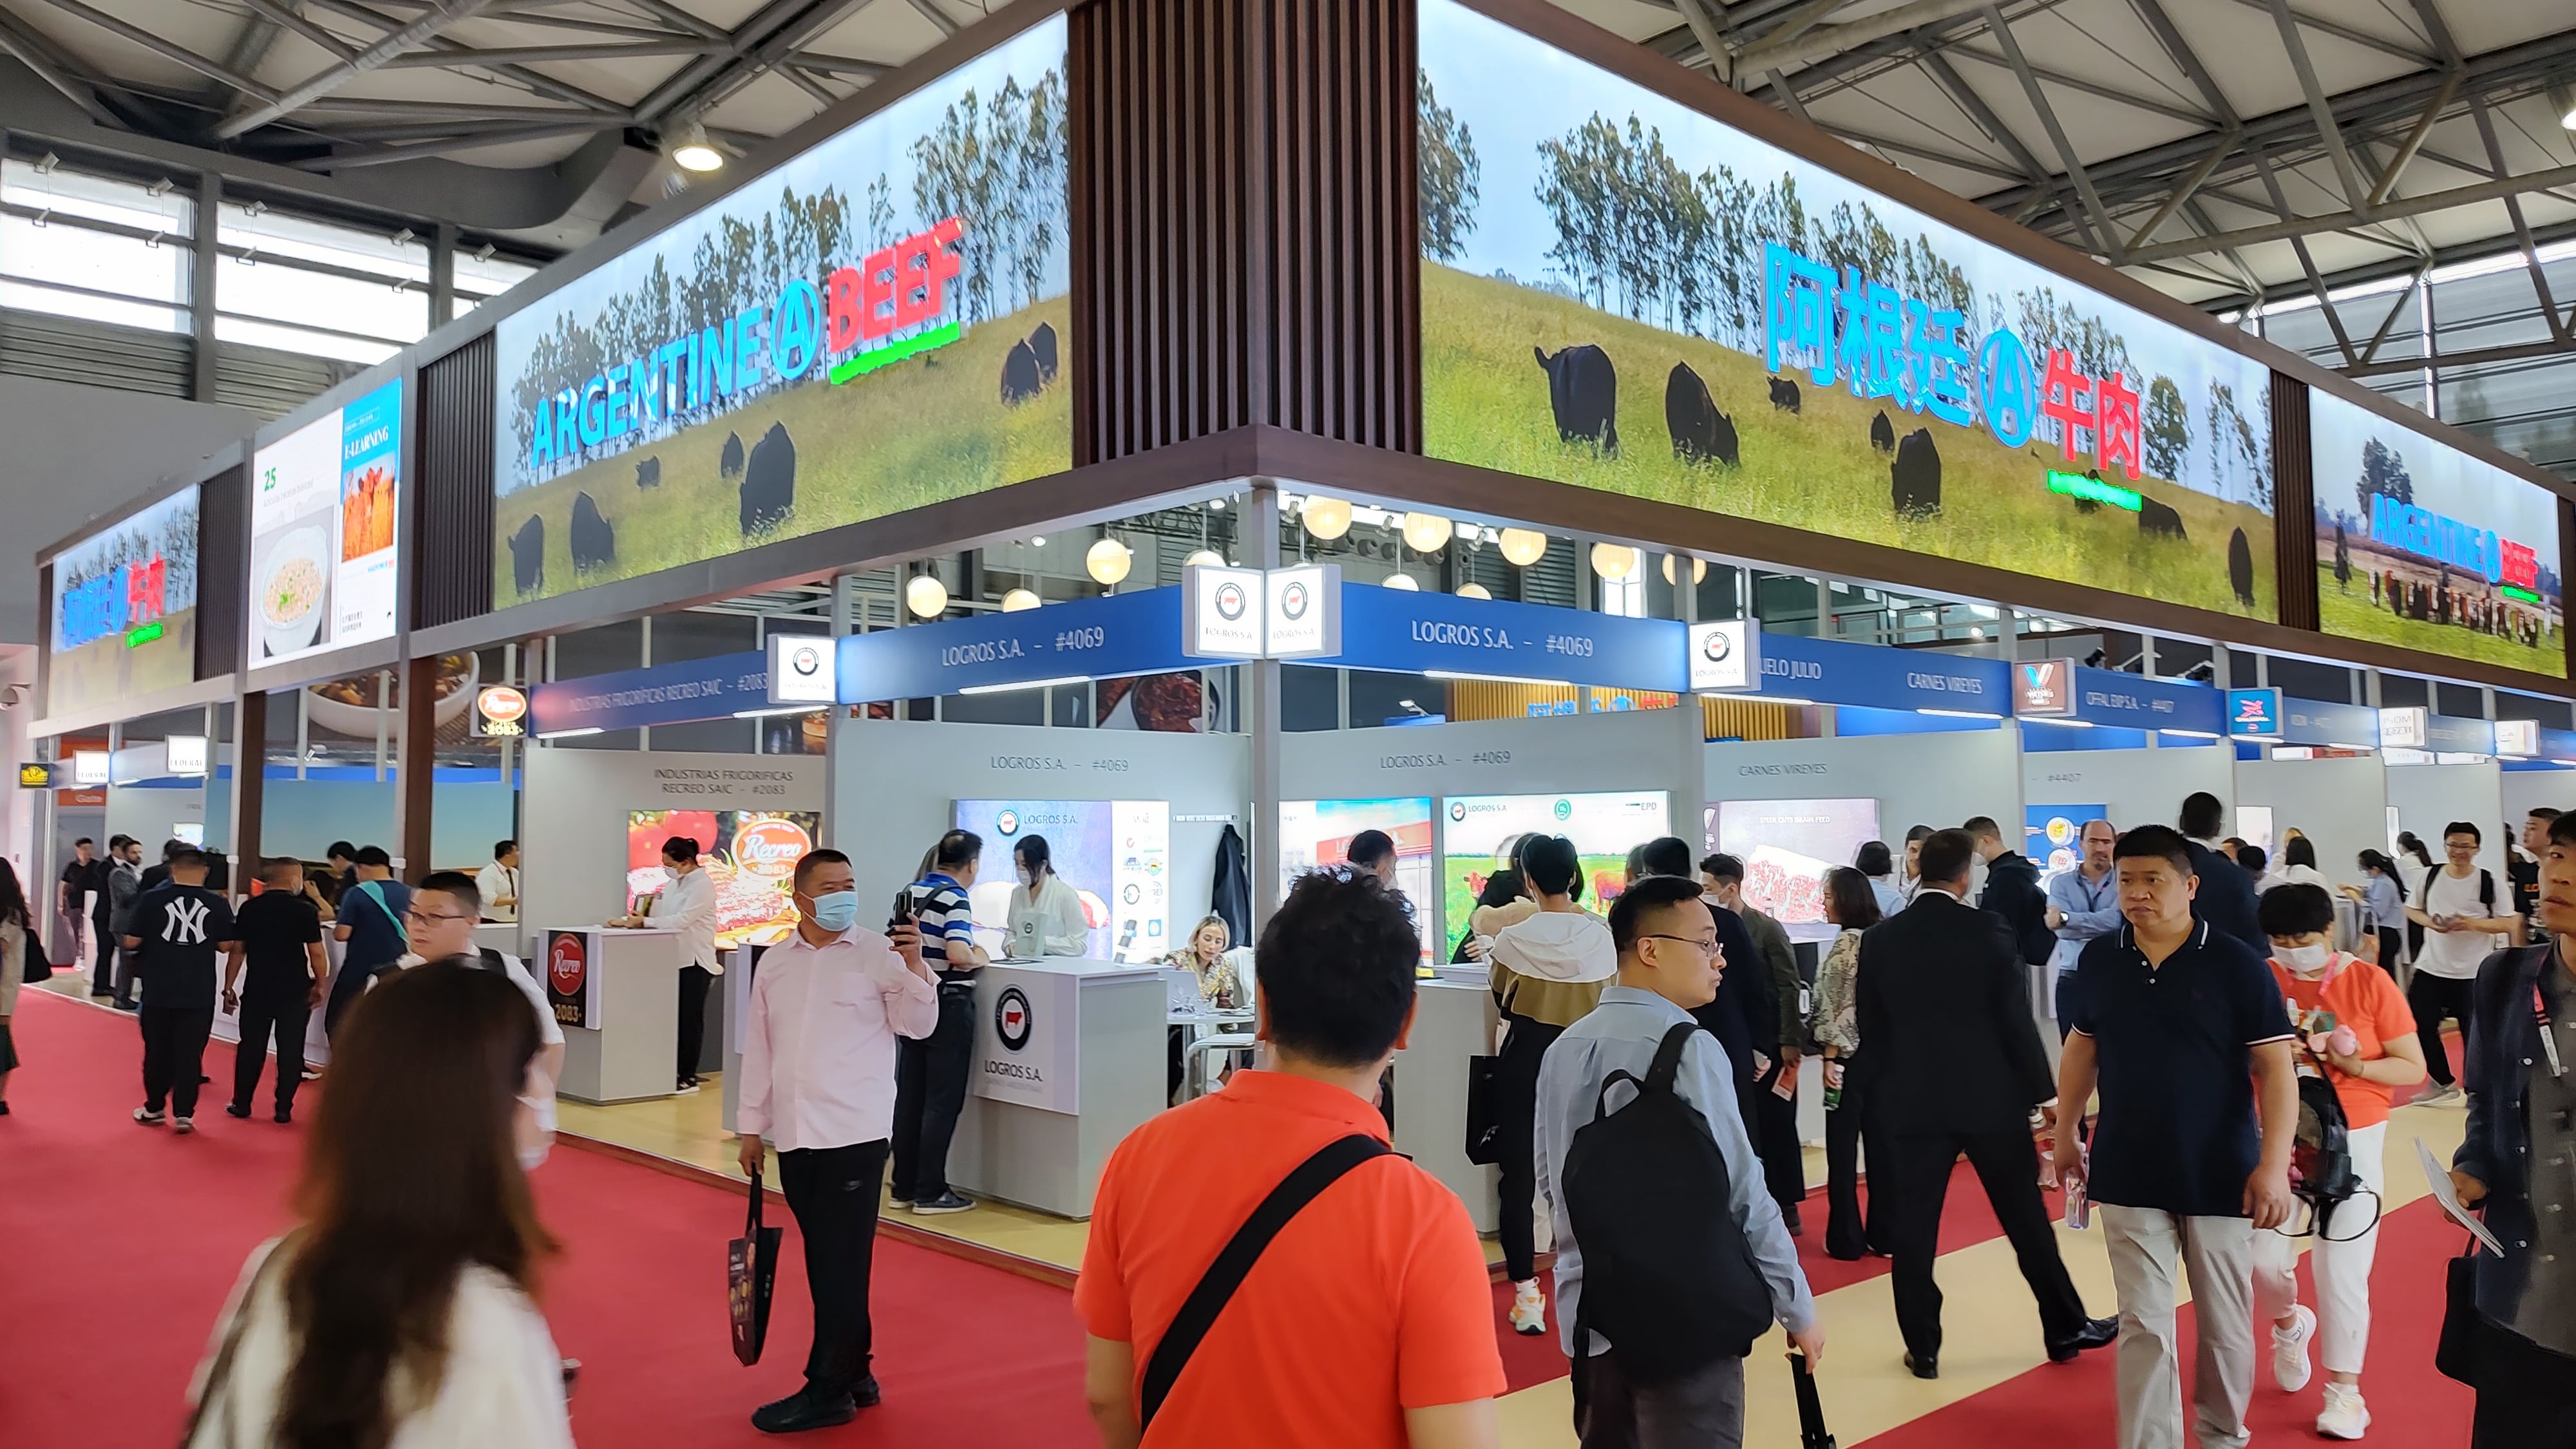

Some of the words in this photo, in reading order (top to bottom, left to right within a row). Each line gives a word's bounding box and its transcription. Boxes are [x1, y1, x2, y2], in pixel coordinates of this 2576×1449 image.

[531, 307, 768, 469] ARGENTINE
[829, 216, 963, 354] BEEF
[1762, 240, 1971, 428] 阿根廷
[2043, 348, 2142, 481] 牛肉
[264, 467, 276, 492] 25
[2371, 492, 2484, 574] ARGENTINE
[942, 641, 995, 667] LOGROS
[998, 638, 1025, 660] S.A.
[1055, 625, 1104, 652] #4069
[1411, 619, 1480, 647] LOGROS
[1483, 627, 1513, 650] S.A.
[1546, 634, 1593, 658] #4069
[1790, 660, 1822, 679] JULIO
[990, 755, 1041, 770] LOGROS
[1092, 759, 1129, 772] #4069
[1380, 753, 1424, 768] LOGROS
[1472, 750, 1511, 764] #4069
[654, 769, 720, 780] INDUSTRIAS
[662, 783, 705, 793] RECREO
[708, 784, 733, 794] SAIC
[752, 784, 786, 795] #2083
[1023, 814, 1060, 824] LOGROS
[741, 834, 802, 864] Recreo
[555, 1003, 579, 1023] 2083
[985, 1059, 1023, 1079] LOGROS
[1025, 1066, 1043, 1082] S.A.
